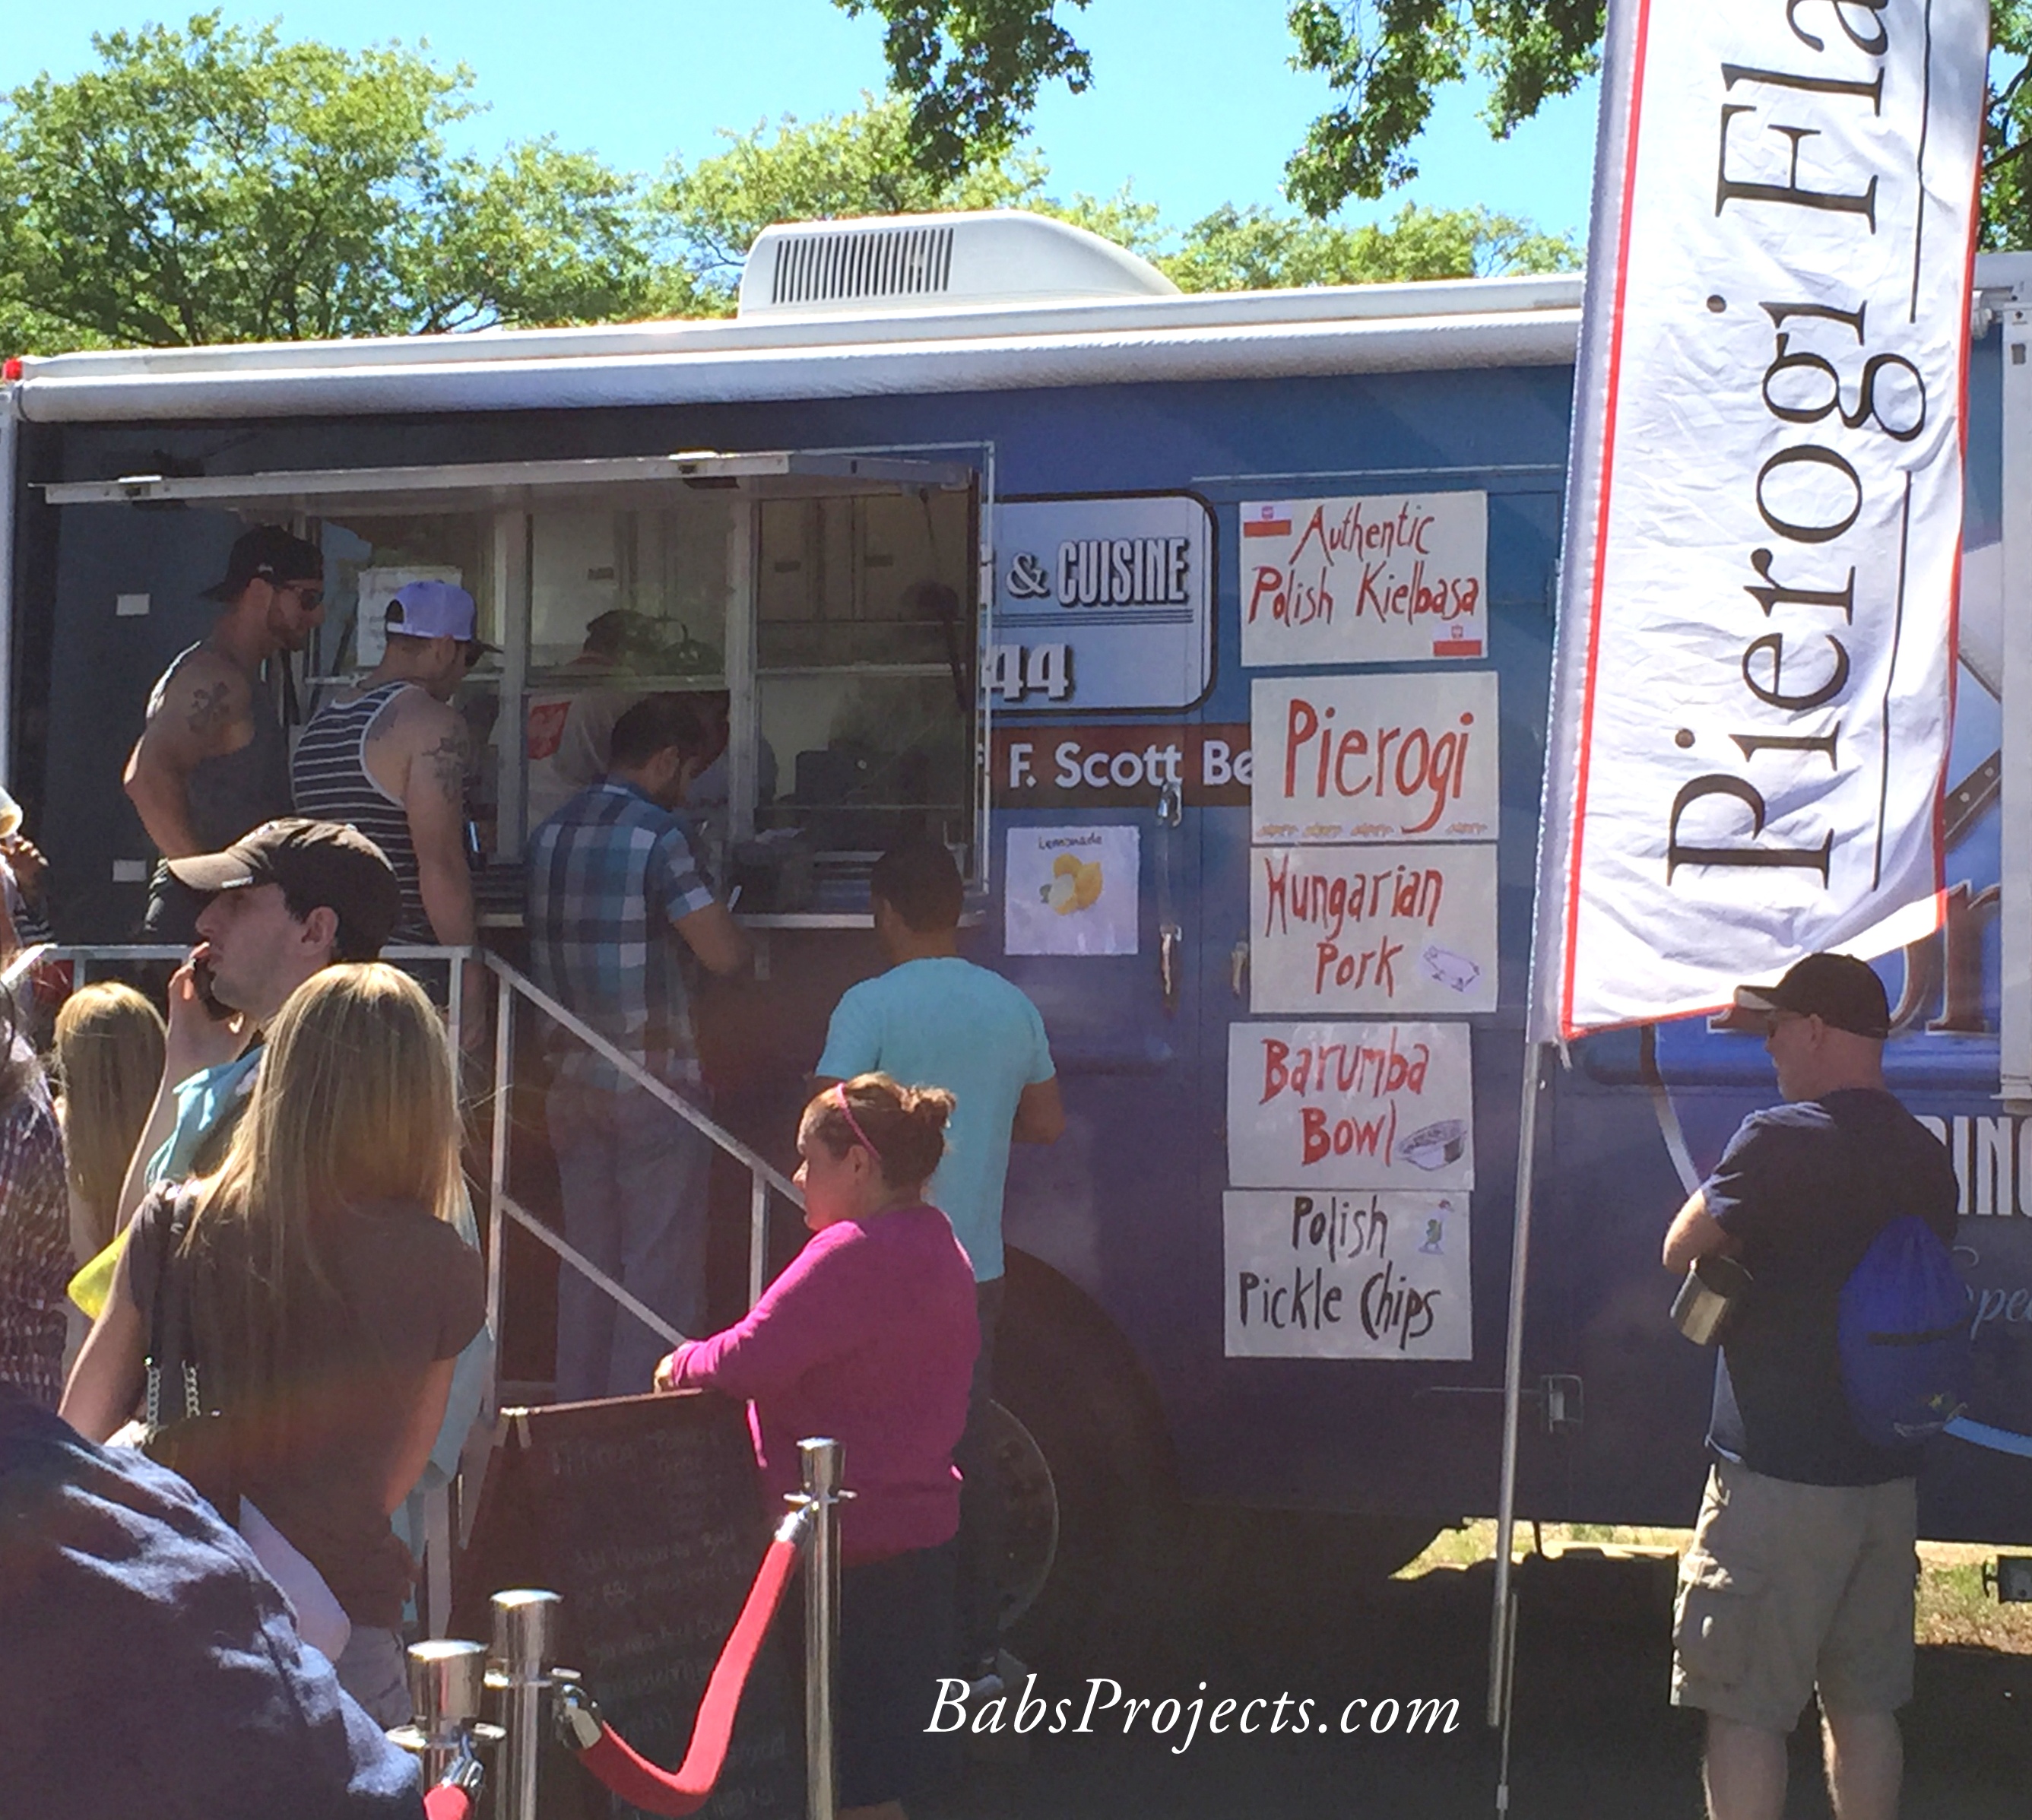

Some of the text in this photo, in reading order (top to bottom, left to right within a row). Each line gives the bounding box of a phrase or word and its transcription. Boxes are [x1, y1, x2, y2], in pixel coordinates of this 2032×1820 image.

[1289, 501, 1435, 566] Authentic
[1006, 552, 1049, 598] &
[1057, 537, 1188, 607] CUISINE
[1248, 560, 1479, 627] Polish Kielbasa
[1667, 294, 1926, 889] Pierogi
[1010, 743, 1037, 788] F.
[1054, 741, 1184, 788] Scott
[1283, 699, 1475, 834] Pierogi
[1038, 832, 1103, 851] Lemonade
[1264, 853, 1443, 940] Hungarian
[1315, 935, 1404, 998] Pork
[1258, 1026, 1431, 1105] Barumba
[1300, 1098, 1397, 1168] Bowl
[1292, 1194, 1389, 1263] Polish
[1238, 1259, 1442, 1350] Pickle Chips
